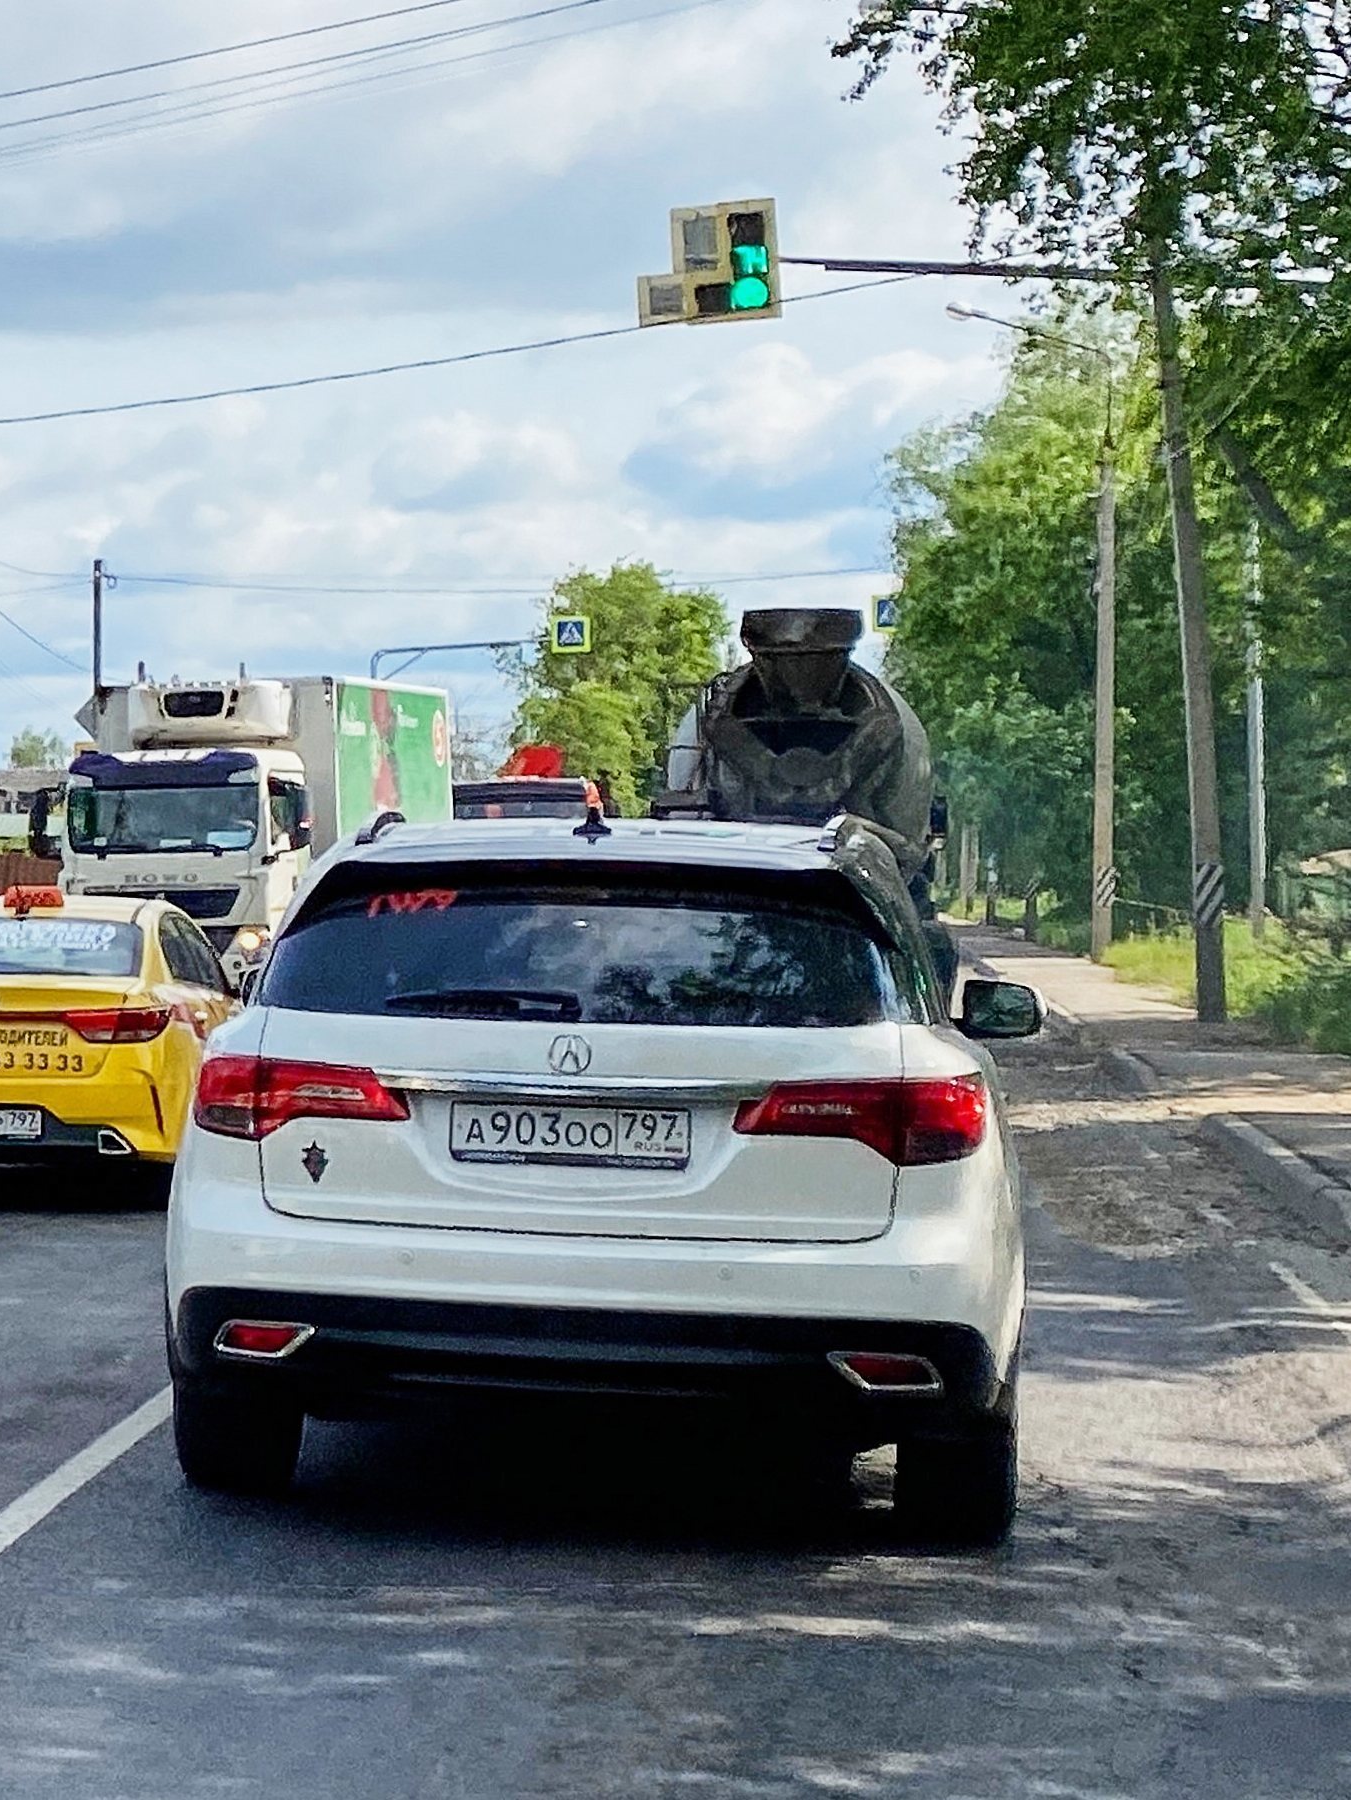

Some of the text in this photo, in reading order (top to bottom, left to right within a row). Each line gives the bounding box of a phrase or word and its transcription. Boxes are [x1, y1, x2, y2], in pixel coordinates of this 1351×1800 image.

[23, 1052, 50, 1071] 33
[55, 1053, 84, 1073] 33
[7, 1110, 36, 1128] 797
[619, 1112, 679, 1141] 797
[632, 1142, 662, 1152] RUS
